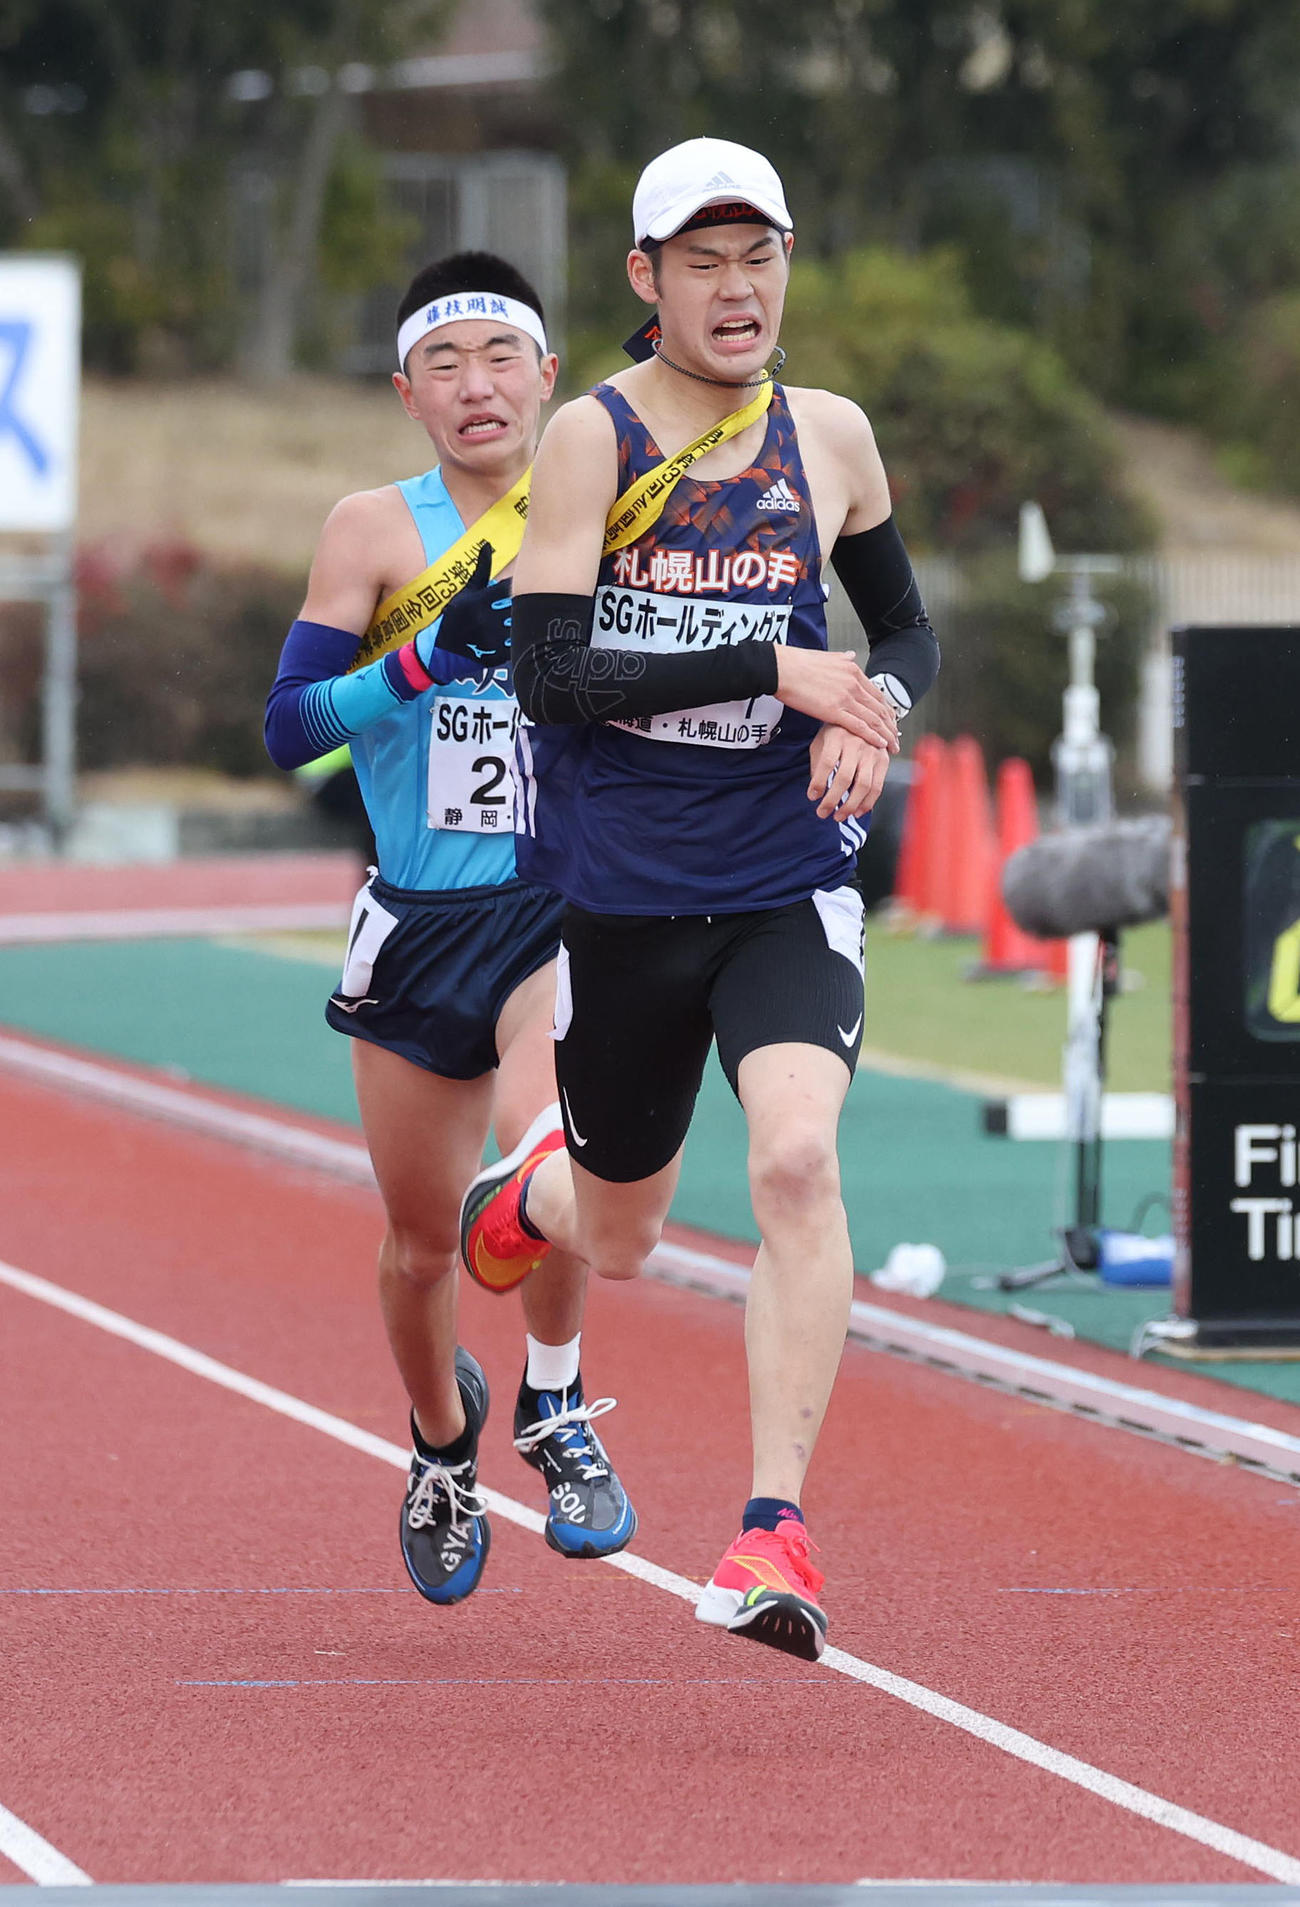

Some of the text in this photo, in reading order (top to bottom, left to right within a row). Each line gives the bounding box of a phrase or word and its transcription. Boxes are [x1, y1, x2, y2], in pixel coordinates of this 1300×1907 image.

[756, 497, 800, 512] adidas
[613, 548, 798, 593] 札幌山の手
[599, 591, 787, 648] SGホールディングス
[1235, 1124, 1300, 1187] Fi
[1230, 1197, 1300, 1261] Ti
